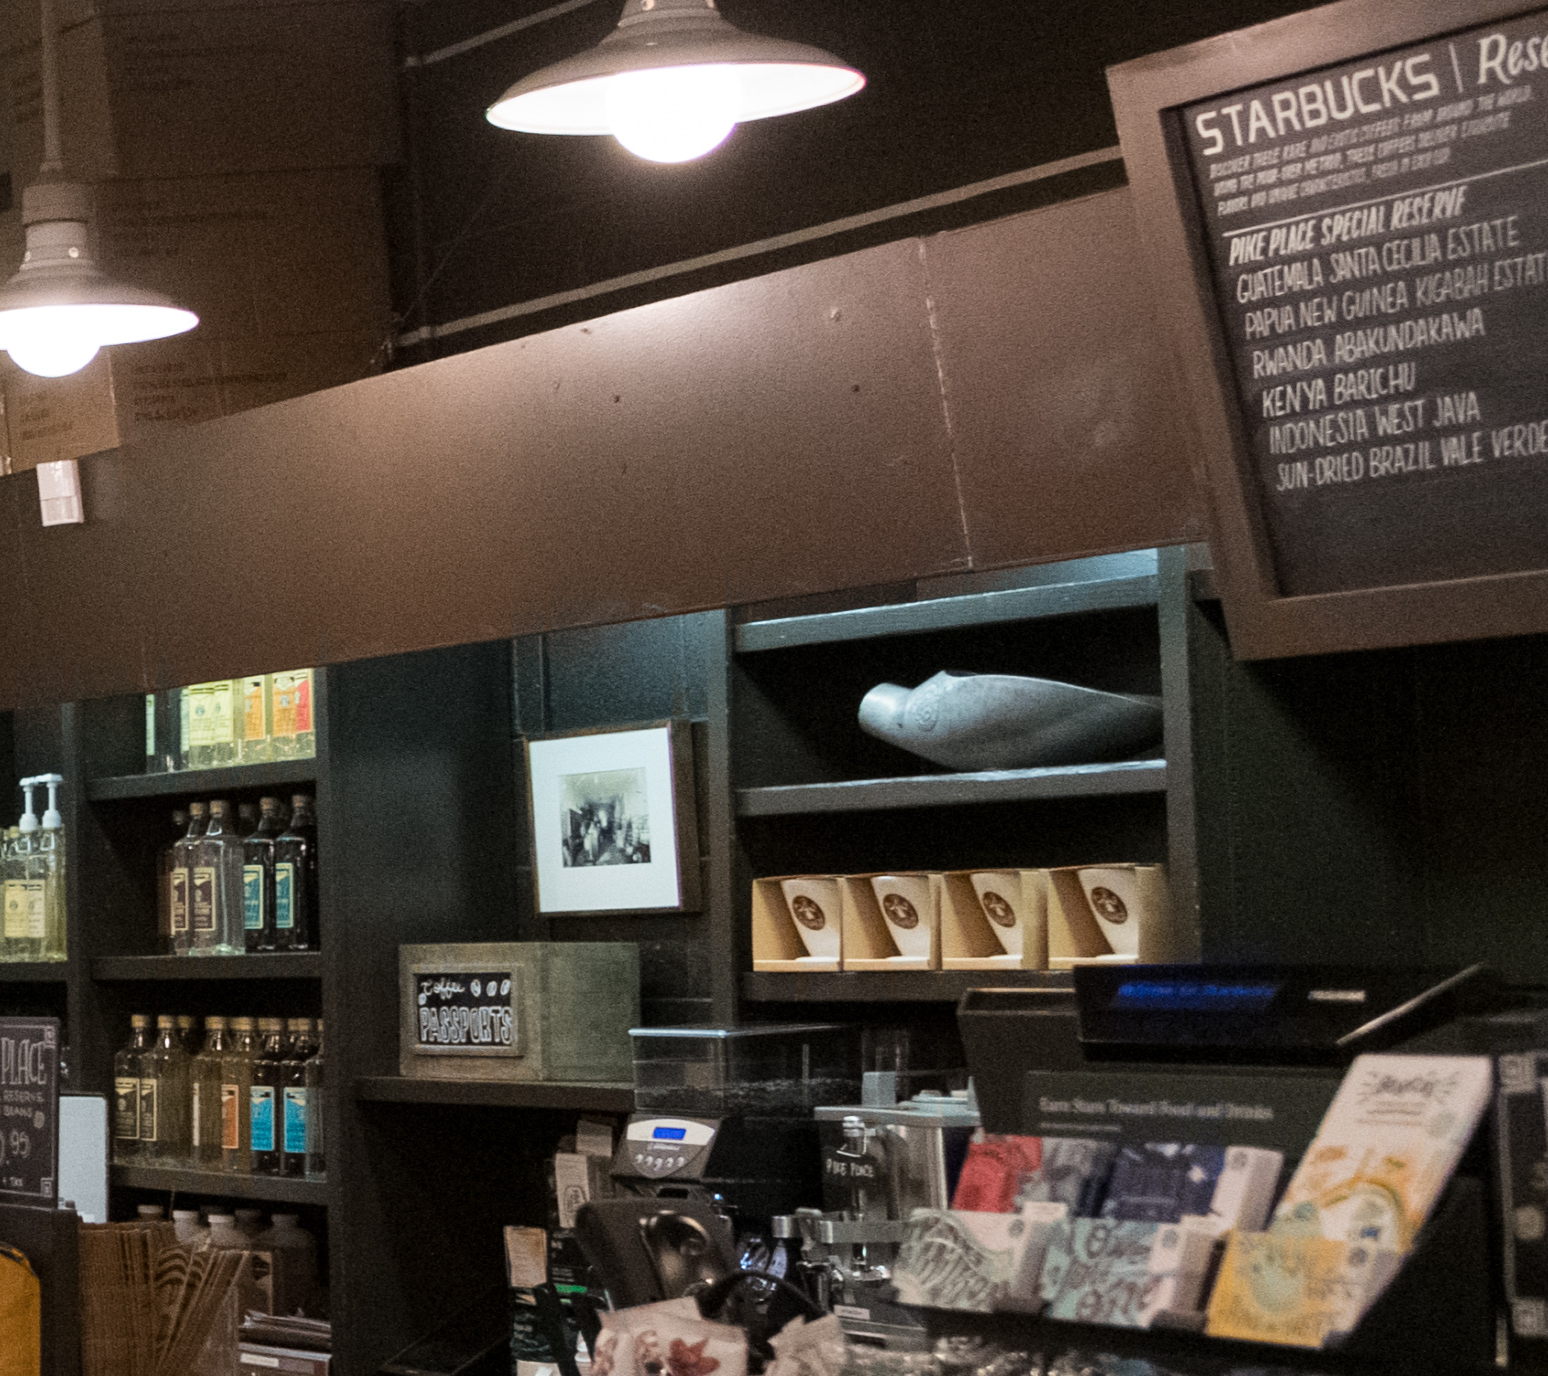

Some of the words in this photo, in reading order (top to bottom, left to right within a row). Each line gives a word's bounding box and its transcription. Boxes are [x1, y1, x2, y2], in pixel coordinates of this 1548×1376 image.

[1196, 54, 1440, 155] STARBUCKS
[1229, 231, 1267, 266] PIKE
[1269, 220, 1317, 257] PLACE
[1321, 206, 1386, 245] SPECIAL
[1391, 186, 1468, 231] RESERVE
[1237, 258, 1323, 303] GUATEMALA
[1329, 247, 1381, 282] SANTA
[1383, 233, 1441, 270] CECILIA
[1447, 216, 1520, 260] ESTATE
[1245, 305, 1295, 339] PAPUA
[1300, 296, 1337, 329] NEW
[1342, 281, 1407, 320] GUINEA
[1253, 339, 1327, 378] RWANDA
[1335, 307, 1485, 364] ABAKUNDAKAWA
[1262, 378, 1327, 418] KENYA
[1334, 362, 1416, 404] BARICHU
[1270, 409, 1369, 454] INDONESIA
[1375, 399, 1425, 437] WEST
[1432, 391, 1481, 427] JAVA
[1276, 452, 1364, 492] SUN-DRIED
[1369, 440, 1436, 478] BRAZIL
[1440, 431, 1484, 466] VALE
[419, 1006, 513, 1044] PASSPORTS
[1, 1037, 47, 1085] PLACE
[3, 1089, 44, 1103] RESERVE
[3, 1105, 33, 1118] BEANS
